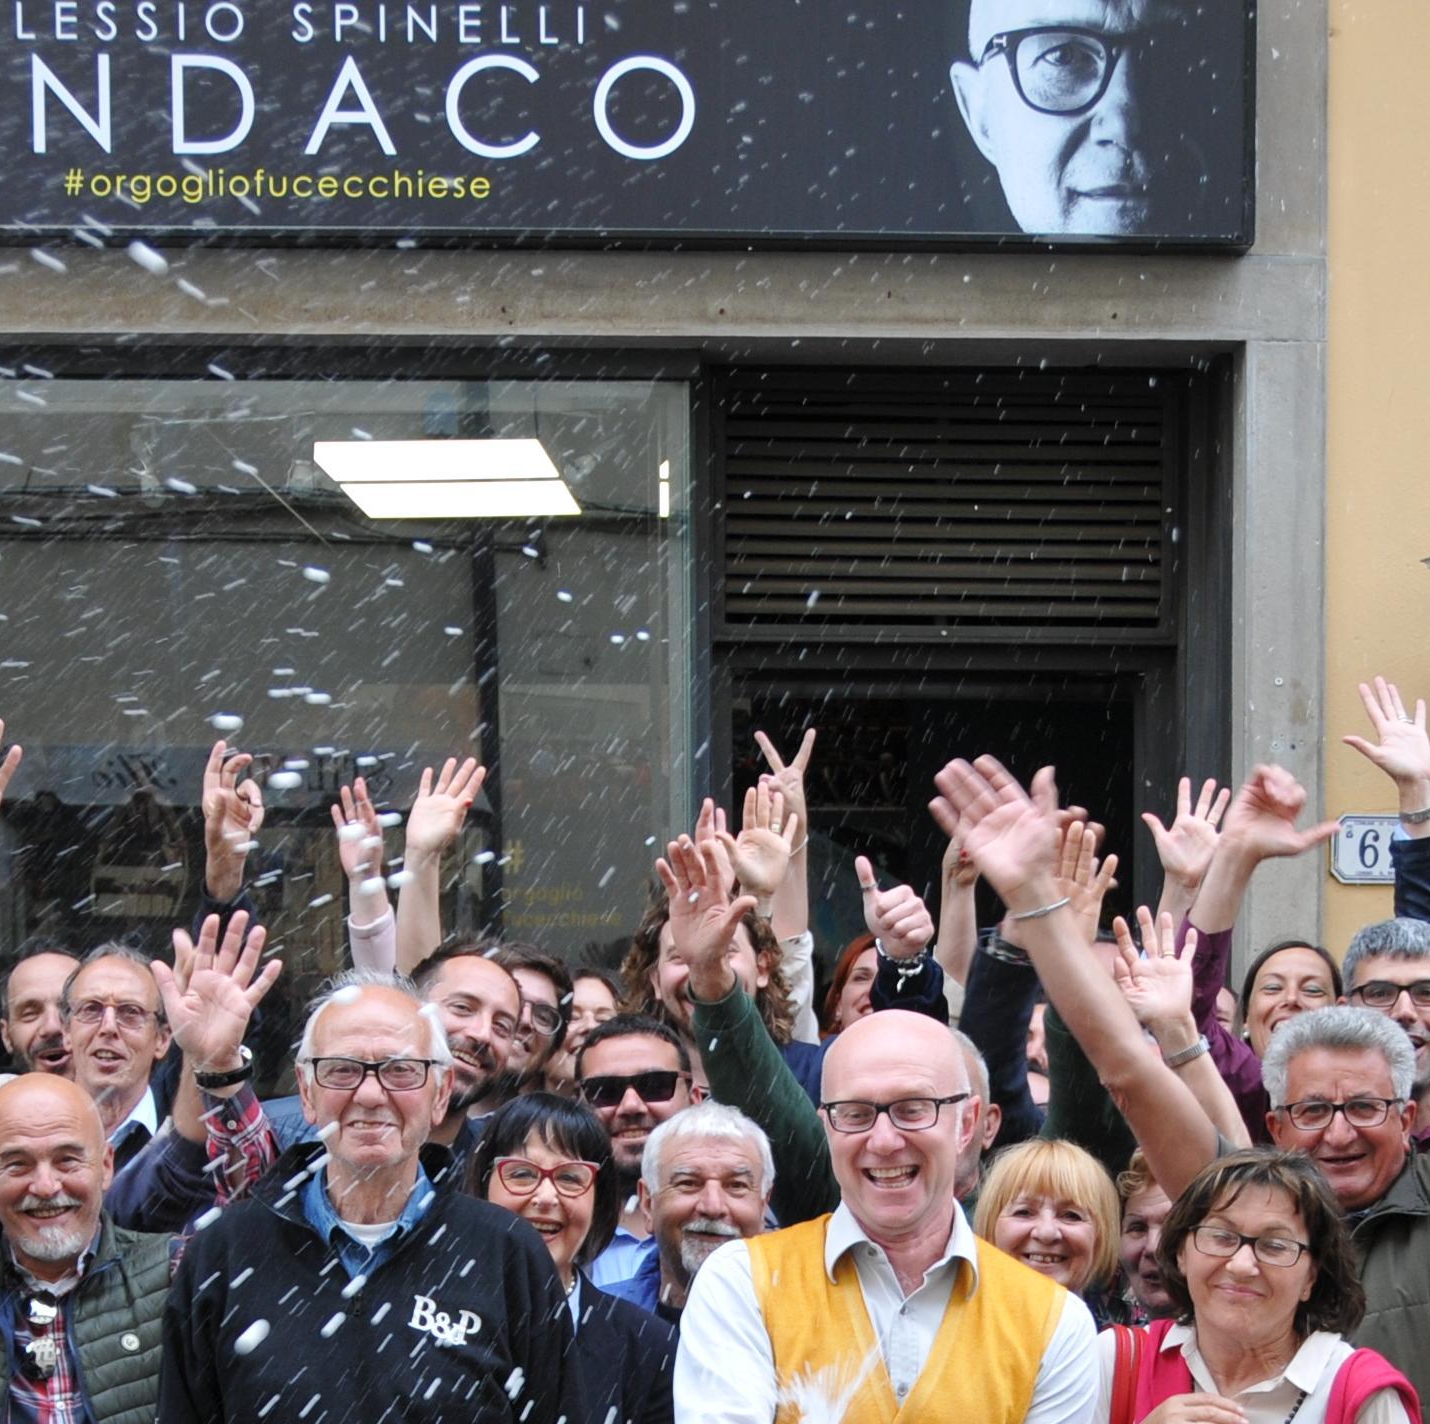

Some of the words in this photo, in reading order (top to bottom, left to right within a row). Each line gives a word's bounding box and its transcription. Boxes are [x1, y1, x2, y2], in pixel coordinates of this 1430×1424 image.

[291, 3, 584, 45] SPINELLI
[64, 168, 492, 204] #orgogliofucecchiese
[407, 1294, 483, 1346] B&P
